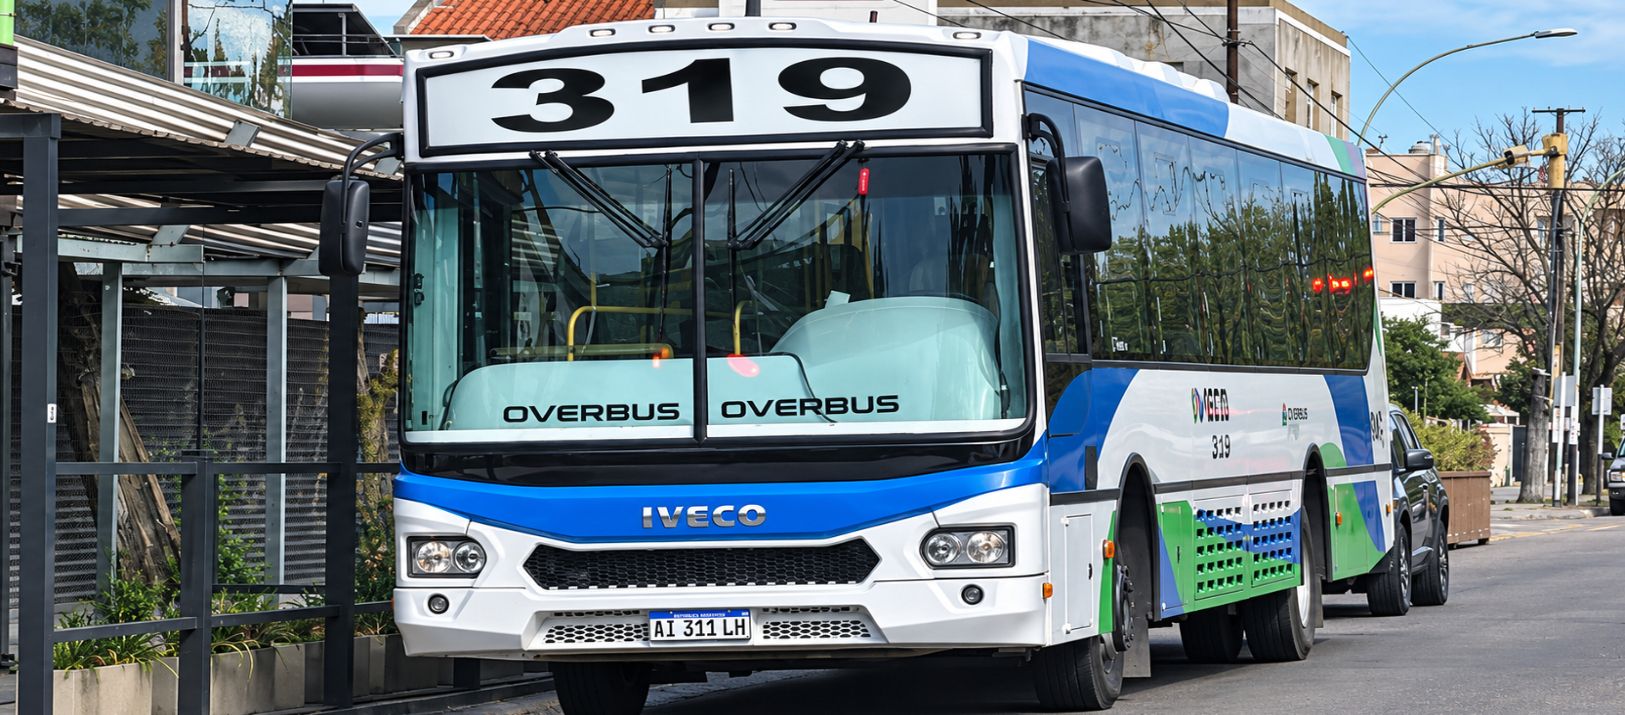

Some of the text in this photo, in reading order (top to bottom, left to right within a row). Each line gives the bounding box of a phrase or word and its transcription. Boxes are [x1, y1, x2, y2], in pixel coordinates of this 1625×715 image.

[491, 57, 912, 133] 319
[503, 403, 681, 423] OVERBUS
[721, 395, 899, 418] OVERBUS
[1211, 434, 1231, 460] 319
[642, 504, 767, 529] IVECO
[654, 618, 746, 638] AI 311 LH
